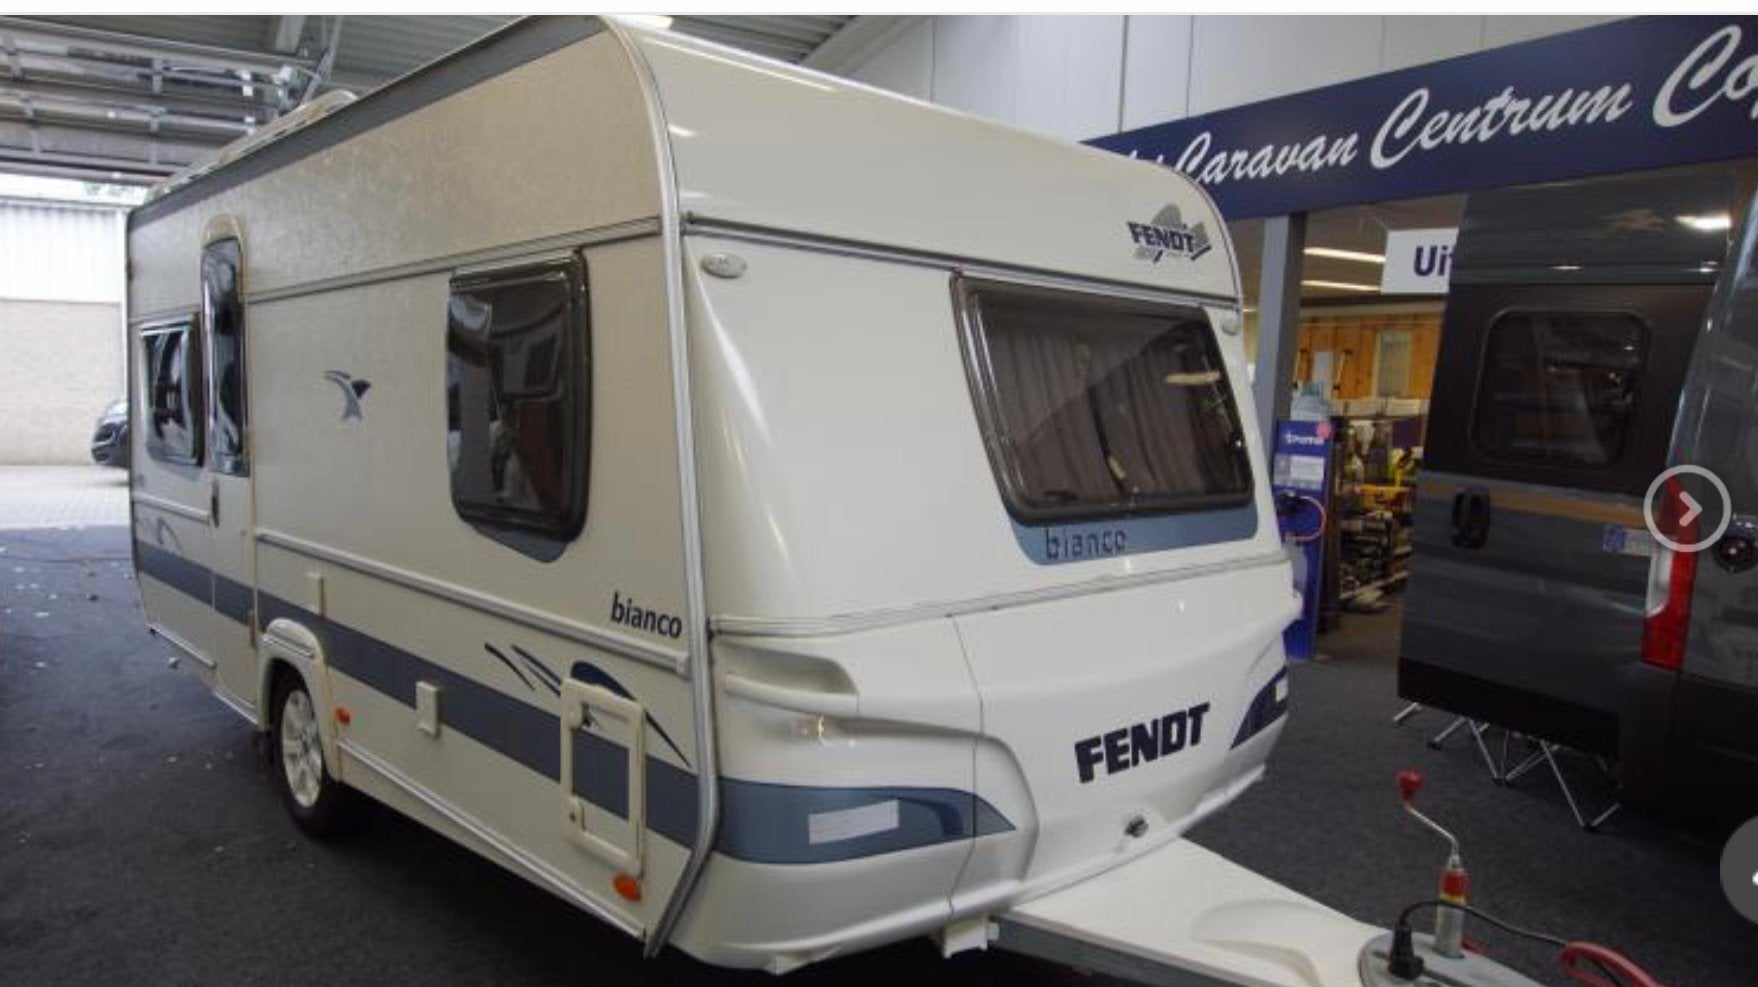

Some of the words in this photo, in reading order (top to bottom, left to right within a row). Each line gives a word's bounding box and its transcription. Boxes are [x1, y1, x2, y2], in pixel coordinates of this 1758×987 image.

[1174, 130, 1359, 184] Caravan
[1370, 83, 1634, 169] Centrum
[1652, 24, 1758, 127] Co
[1127, 220, 1194, 253] FENDT
[1413, 244, 1454, 277] Ui
[1046, 527, 1126, 560] bianco
[611, 590, 682, 639] bianco
[1074, 702, 1210, 784] FENDT
